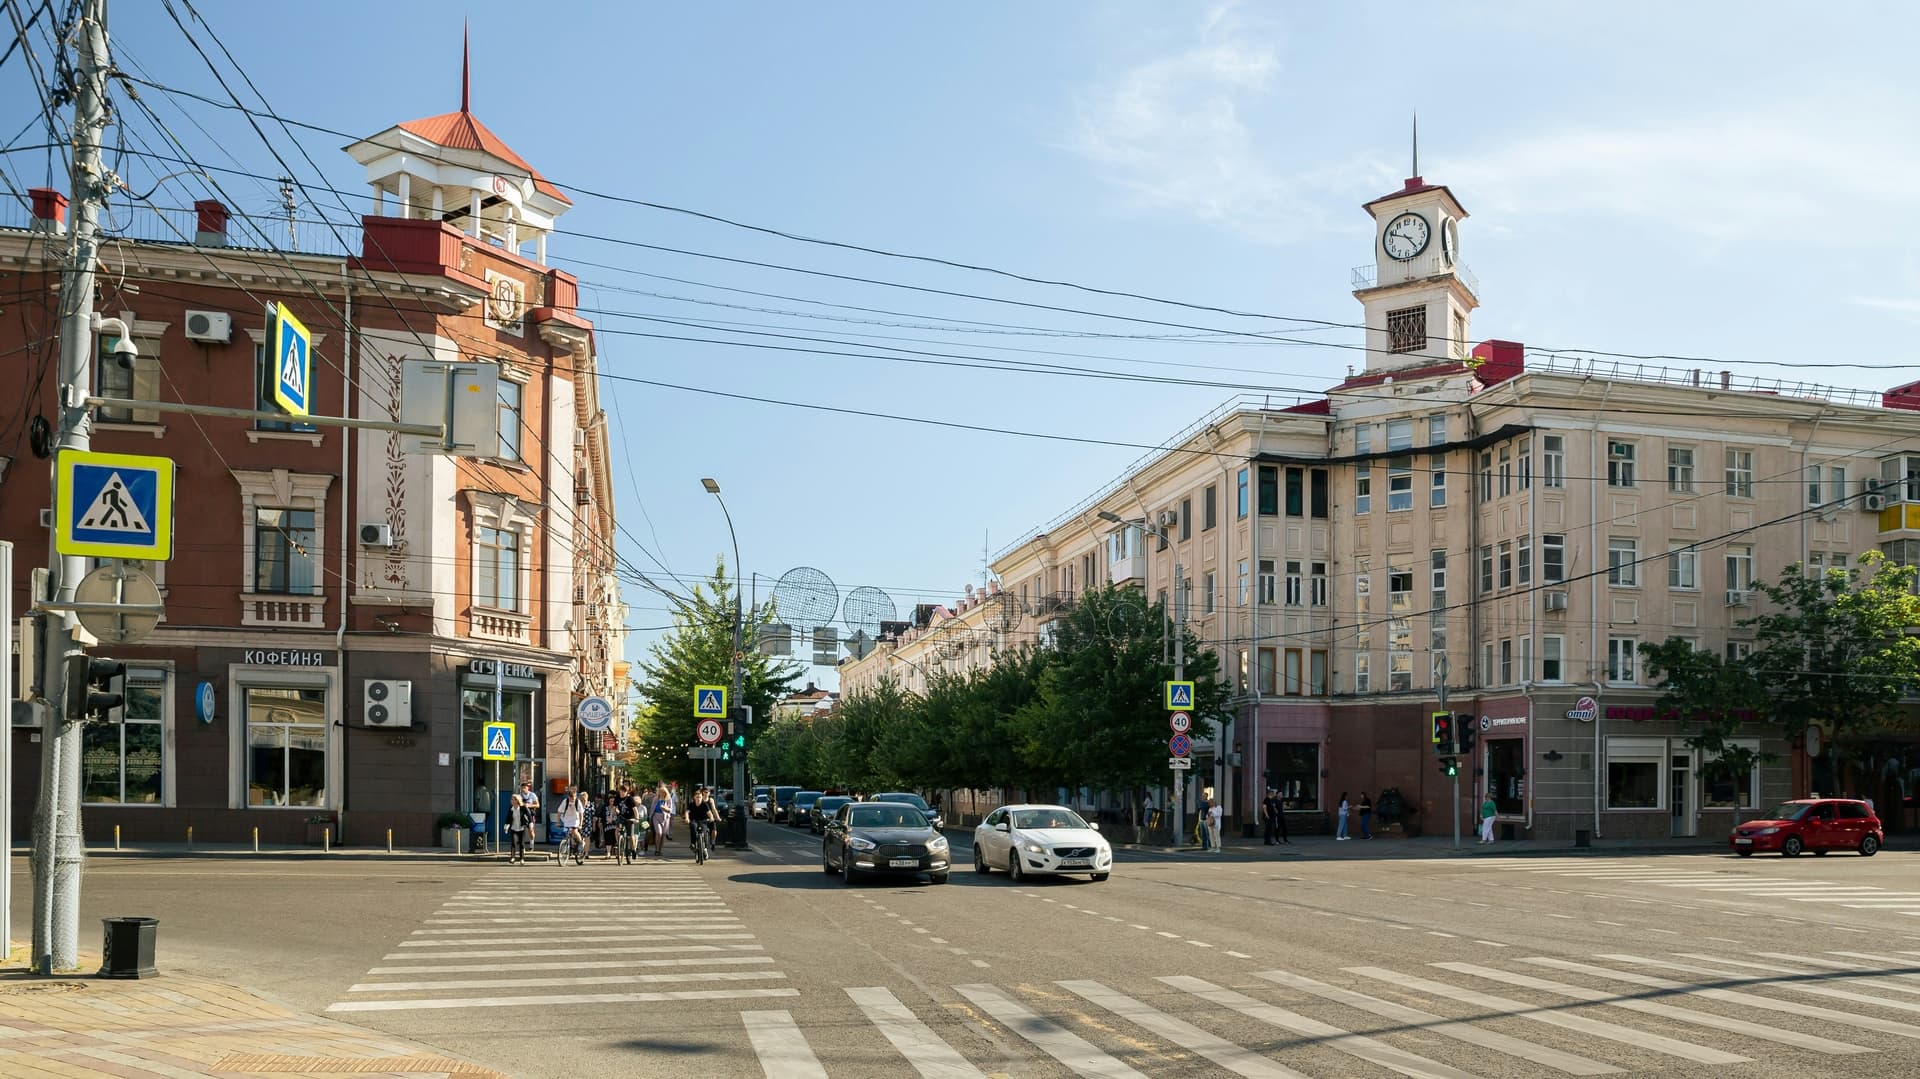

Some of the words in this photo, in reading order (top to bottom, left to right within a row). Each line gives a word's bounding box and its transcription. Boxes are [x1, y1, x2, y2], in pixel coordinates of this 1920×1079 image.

[245, 649, 322, 666] КОФЕЙНЯ
[1567, 709, 1592, 718] omni
[1174, 718, 1187, 727] 40
[702, 725, 717, 736] 40
